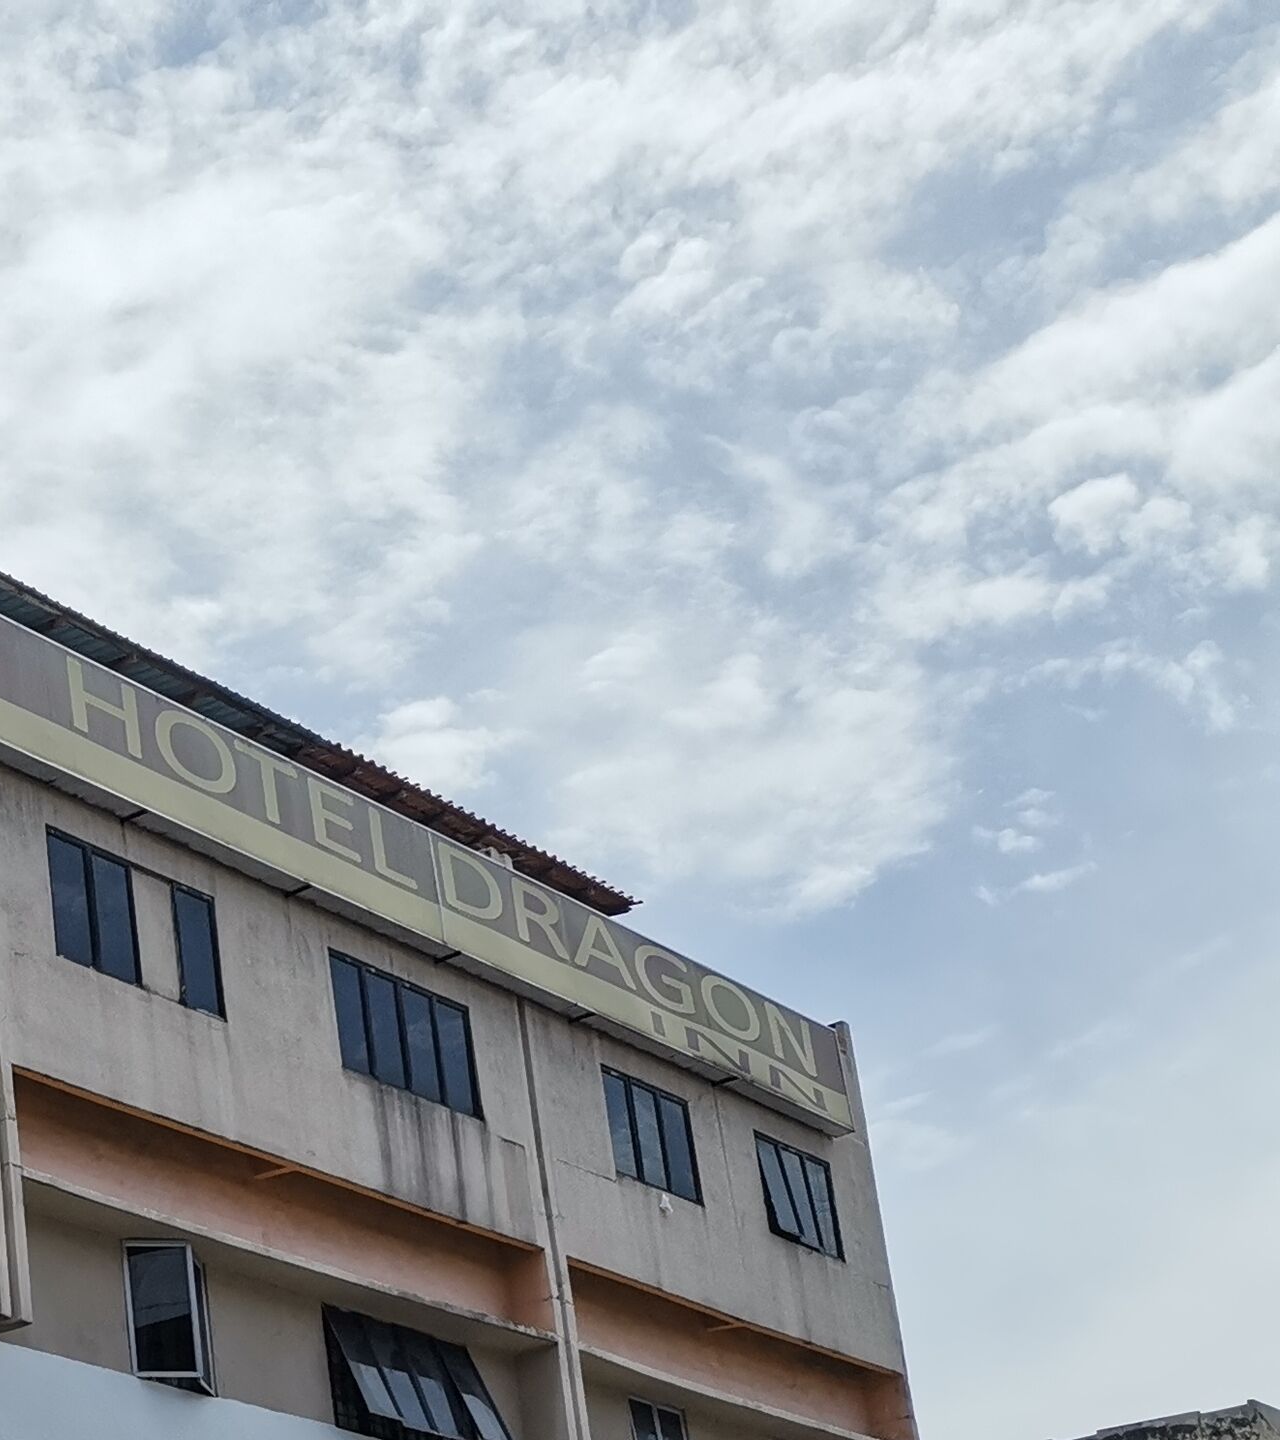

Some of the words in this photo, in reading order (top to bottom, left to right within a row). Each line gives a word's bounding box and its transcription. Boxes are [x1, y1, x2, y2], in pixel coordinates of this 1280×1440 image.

[65, 654, 418, 891] HOTEL
[438, 839, 820, 1080] DRAGON
[650, 1004, 828, 1112] INN
